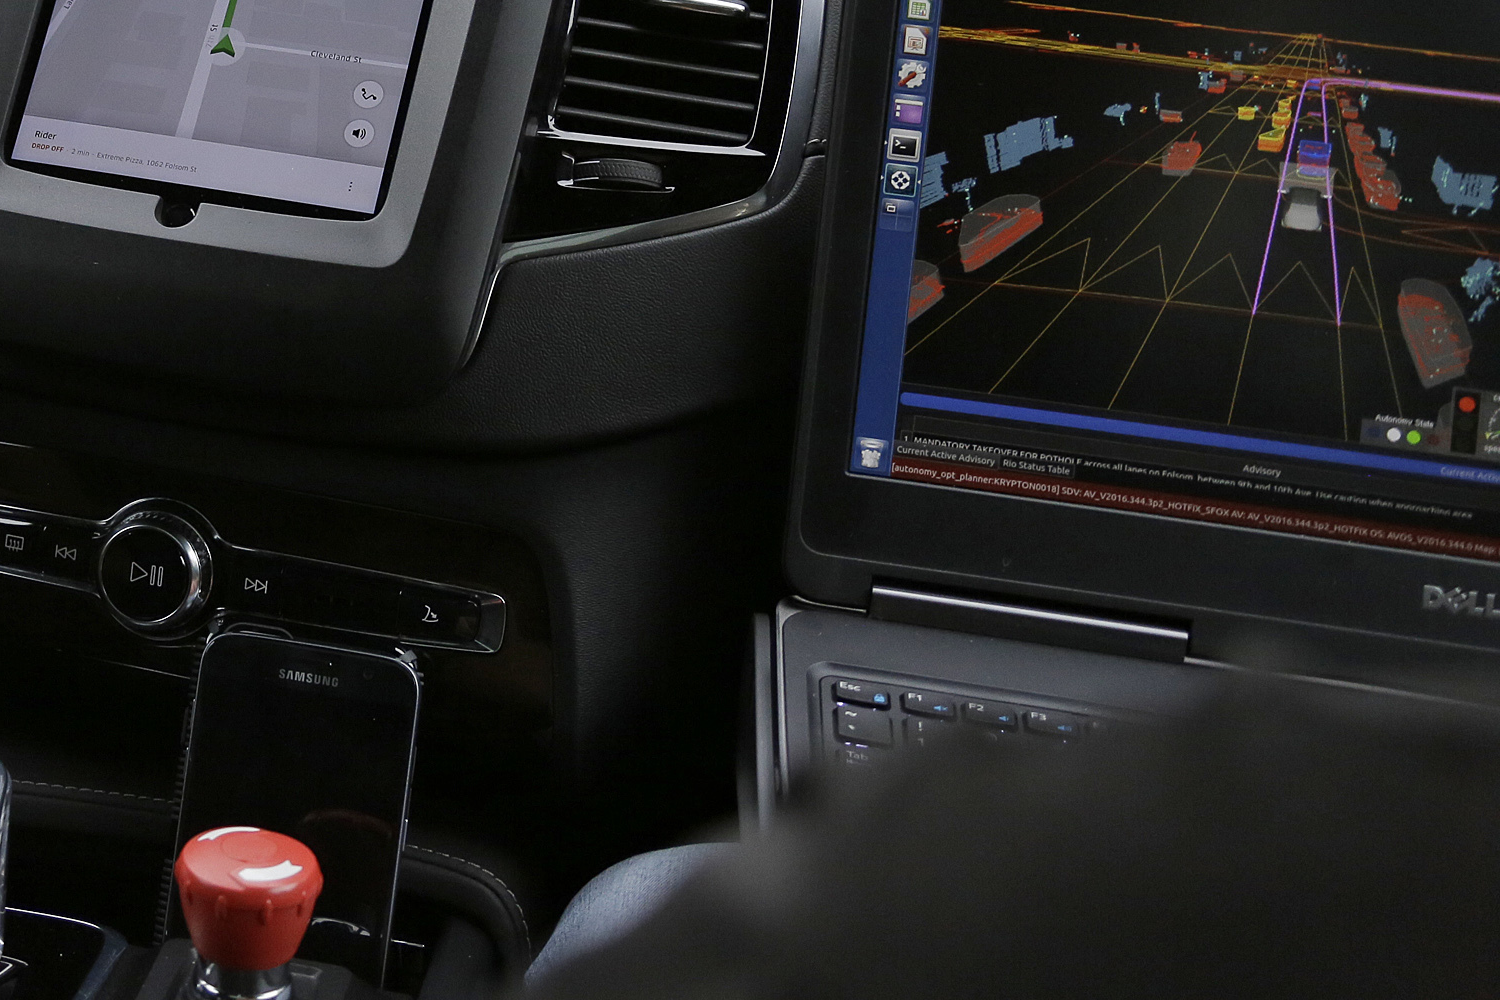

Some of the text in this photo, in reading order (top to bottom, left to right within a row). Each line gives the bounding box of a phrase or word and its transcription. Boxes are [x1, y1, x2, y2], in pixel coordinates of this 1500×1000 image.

[210, 23, 218, 32] St
[310, 50, 351, 62] Cleveland
[34, 130, 57, 141] Rider
[31, 142, 50, 150] DROP
[51, 145, 64, 153] OFF
[96, 152, 124, 162] Extreme
[125, 156, 145, 165] Pizza,
[146, 159, 164, 168] 1062
[165, 162, 188, 171] Folsom
[190, 165, 197, 173] St
[896, 445, 996, 467] Current Active Advisory
[914, 436, 970, 450] MANDATORY
[972, 444, 1018, 457] TAKEOVER
[1020, 450, 1038, 460] FOR
[1040, 453, 1082, 465] POTHOLE
[1003, 459, 1071, 475] Rio Status Table
[1243, 465, 1281, 479] Advisory
[1061, 486, 1082, 497] SDV:
[1230, 509, 1246, 520] AV:
[1421, 584, 1500, 619] DELL
[278, 668, 339, 688] SAMSUNG
[839, 681, 861, 692] Esc
[908, 692, 923, 702] F1
[968, 702, 984, 712] F2
[1031, 711, 1047, 722] F3
